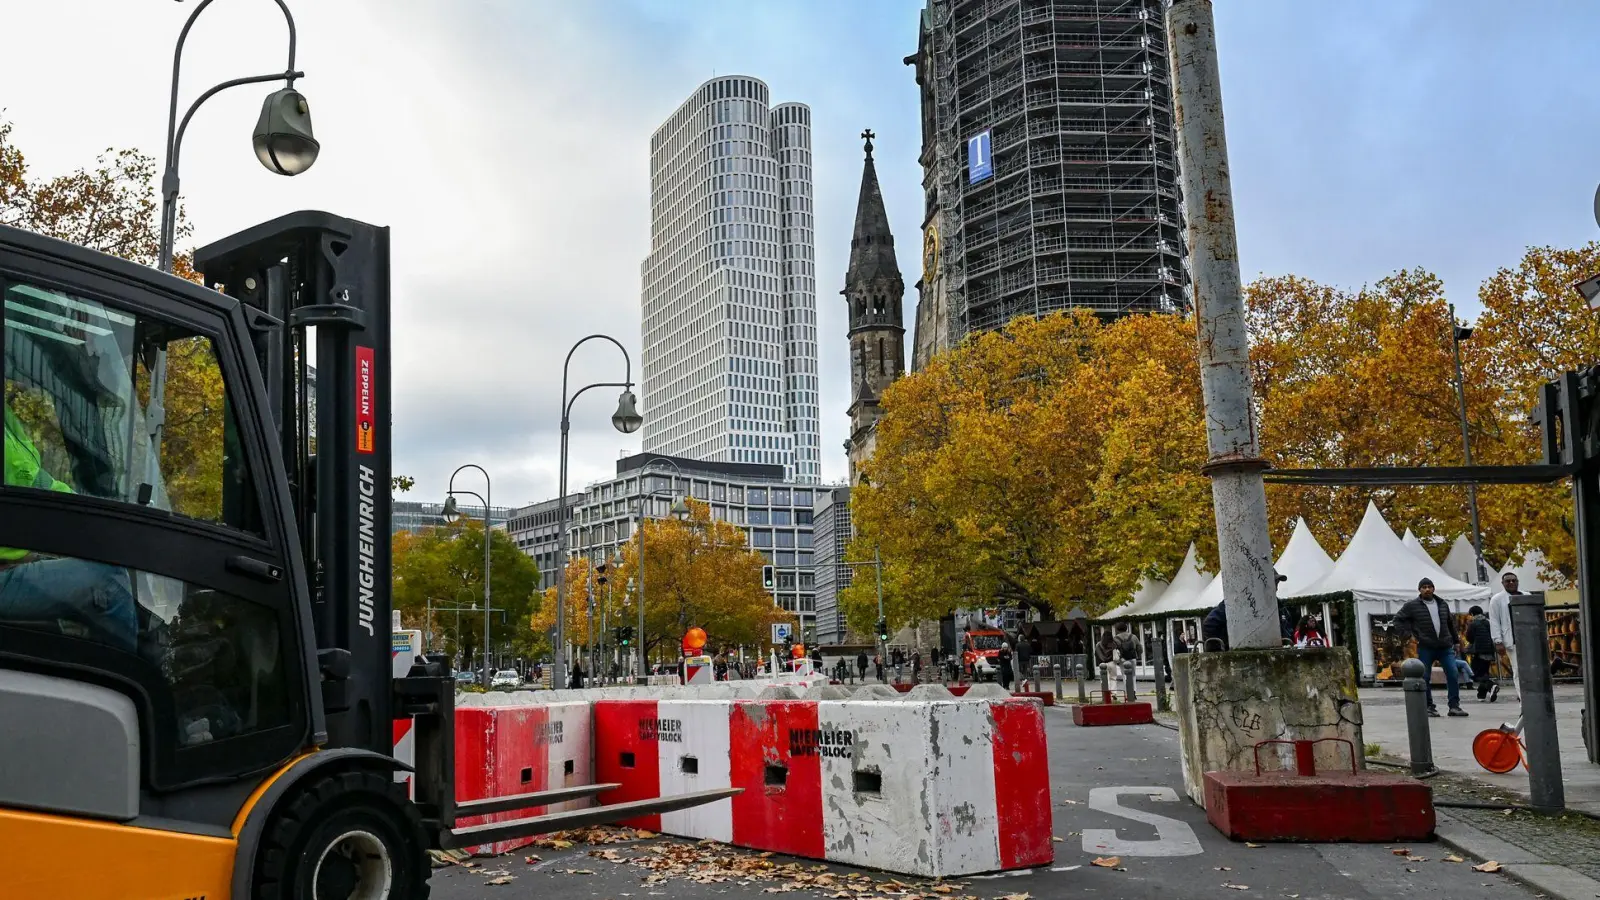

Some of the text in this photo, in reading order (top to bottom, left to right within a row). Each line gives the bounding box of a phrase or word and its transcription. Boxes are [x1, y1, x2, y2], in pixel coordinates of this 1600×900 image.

[969, 131, 989, 168] T
[361, 359, 369, 415] ZEPPELIN
[359, 464, 375, 637] JUNGHEINRICH
[638, 717, 682, 732] NIEMEIER
[789, 728, 853, 746] NIEMEIER
